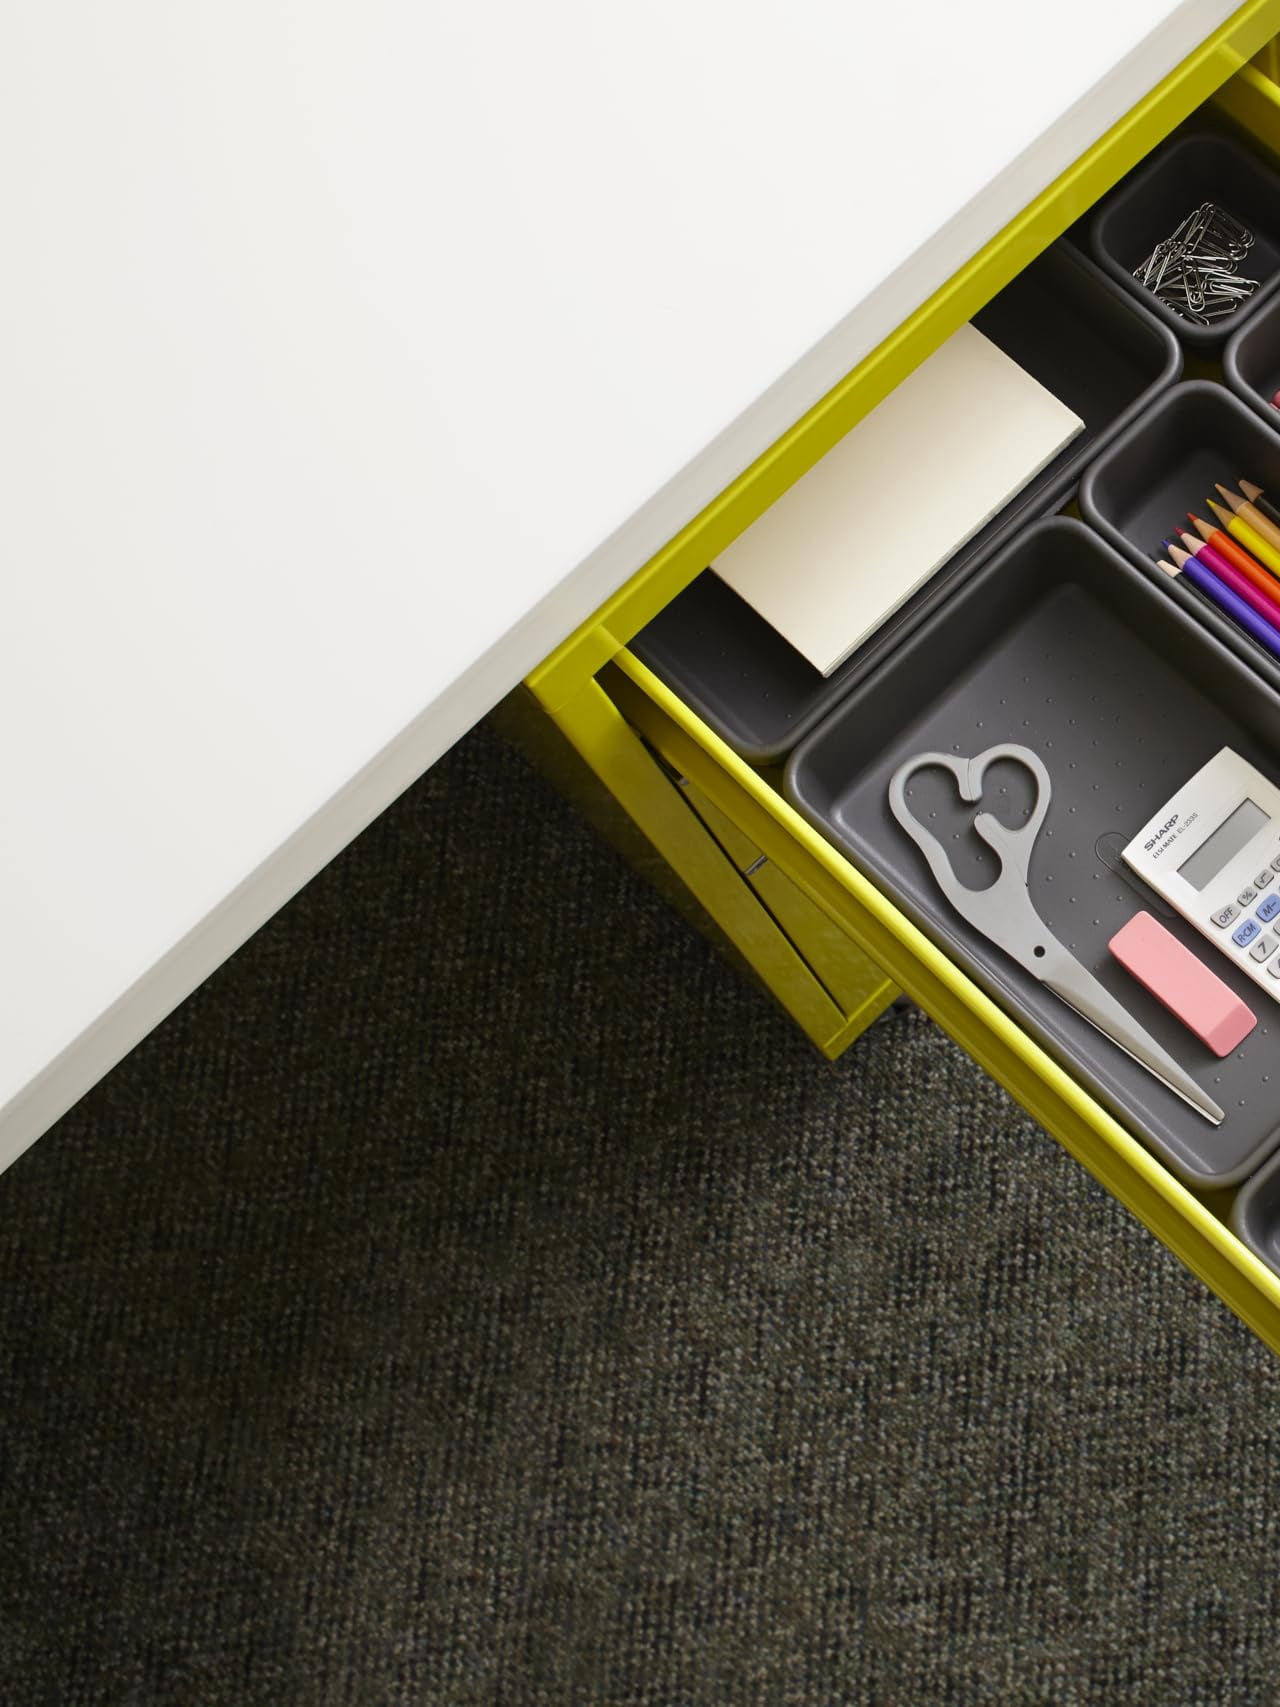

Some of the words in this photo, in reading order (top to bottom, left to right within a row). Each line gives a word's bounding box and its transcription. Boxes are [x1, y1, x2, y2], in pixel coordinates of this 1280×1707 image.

[1143, 813, 1180, 852] SHARP
[1218, 907, 1234, 924] OFF
[1257, 941, 1267, 955] 7
